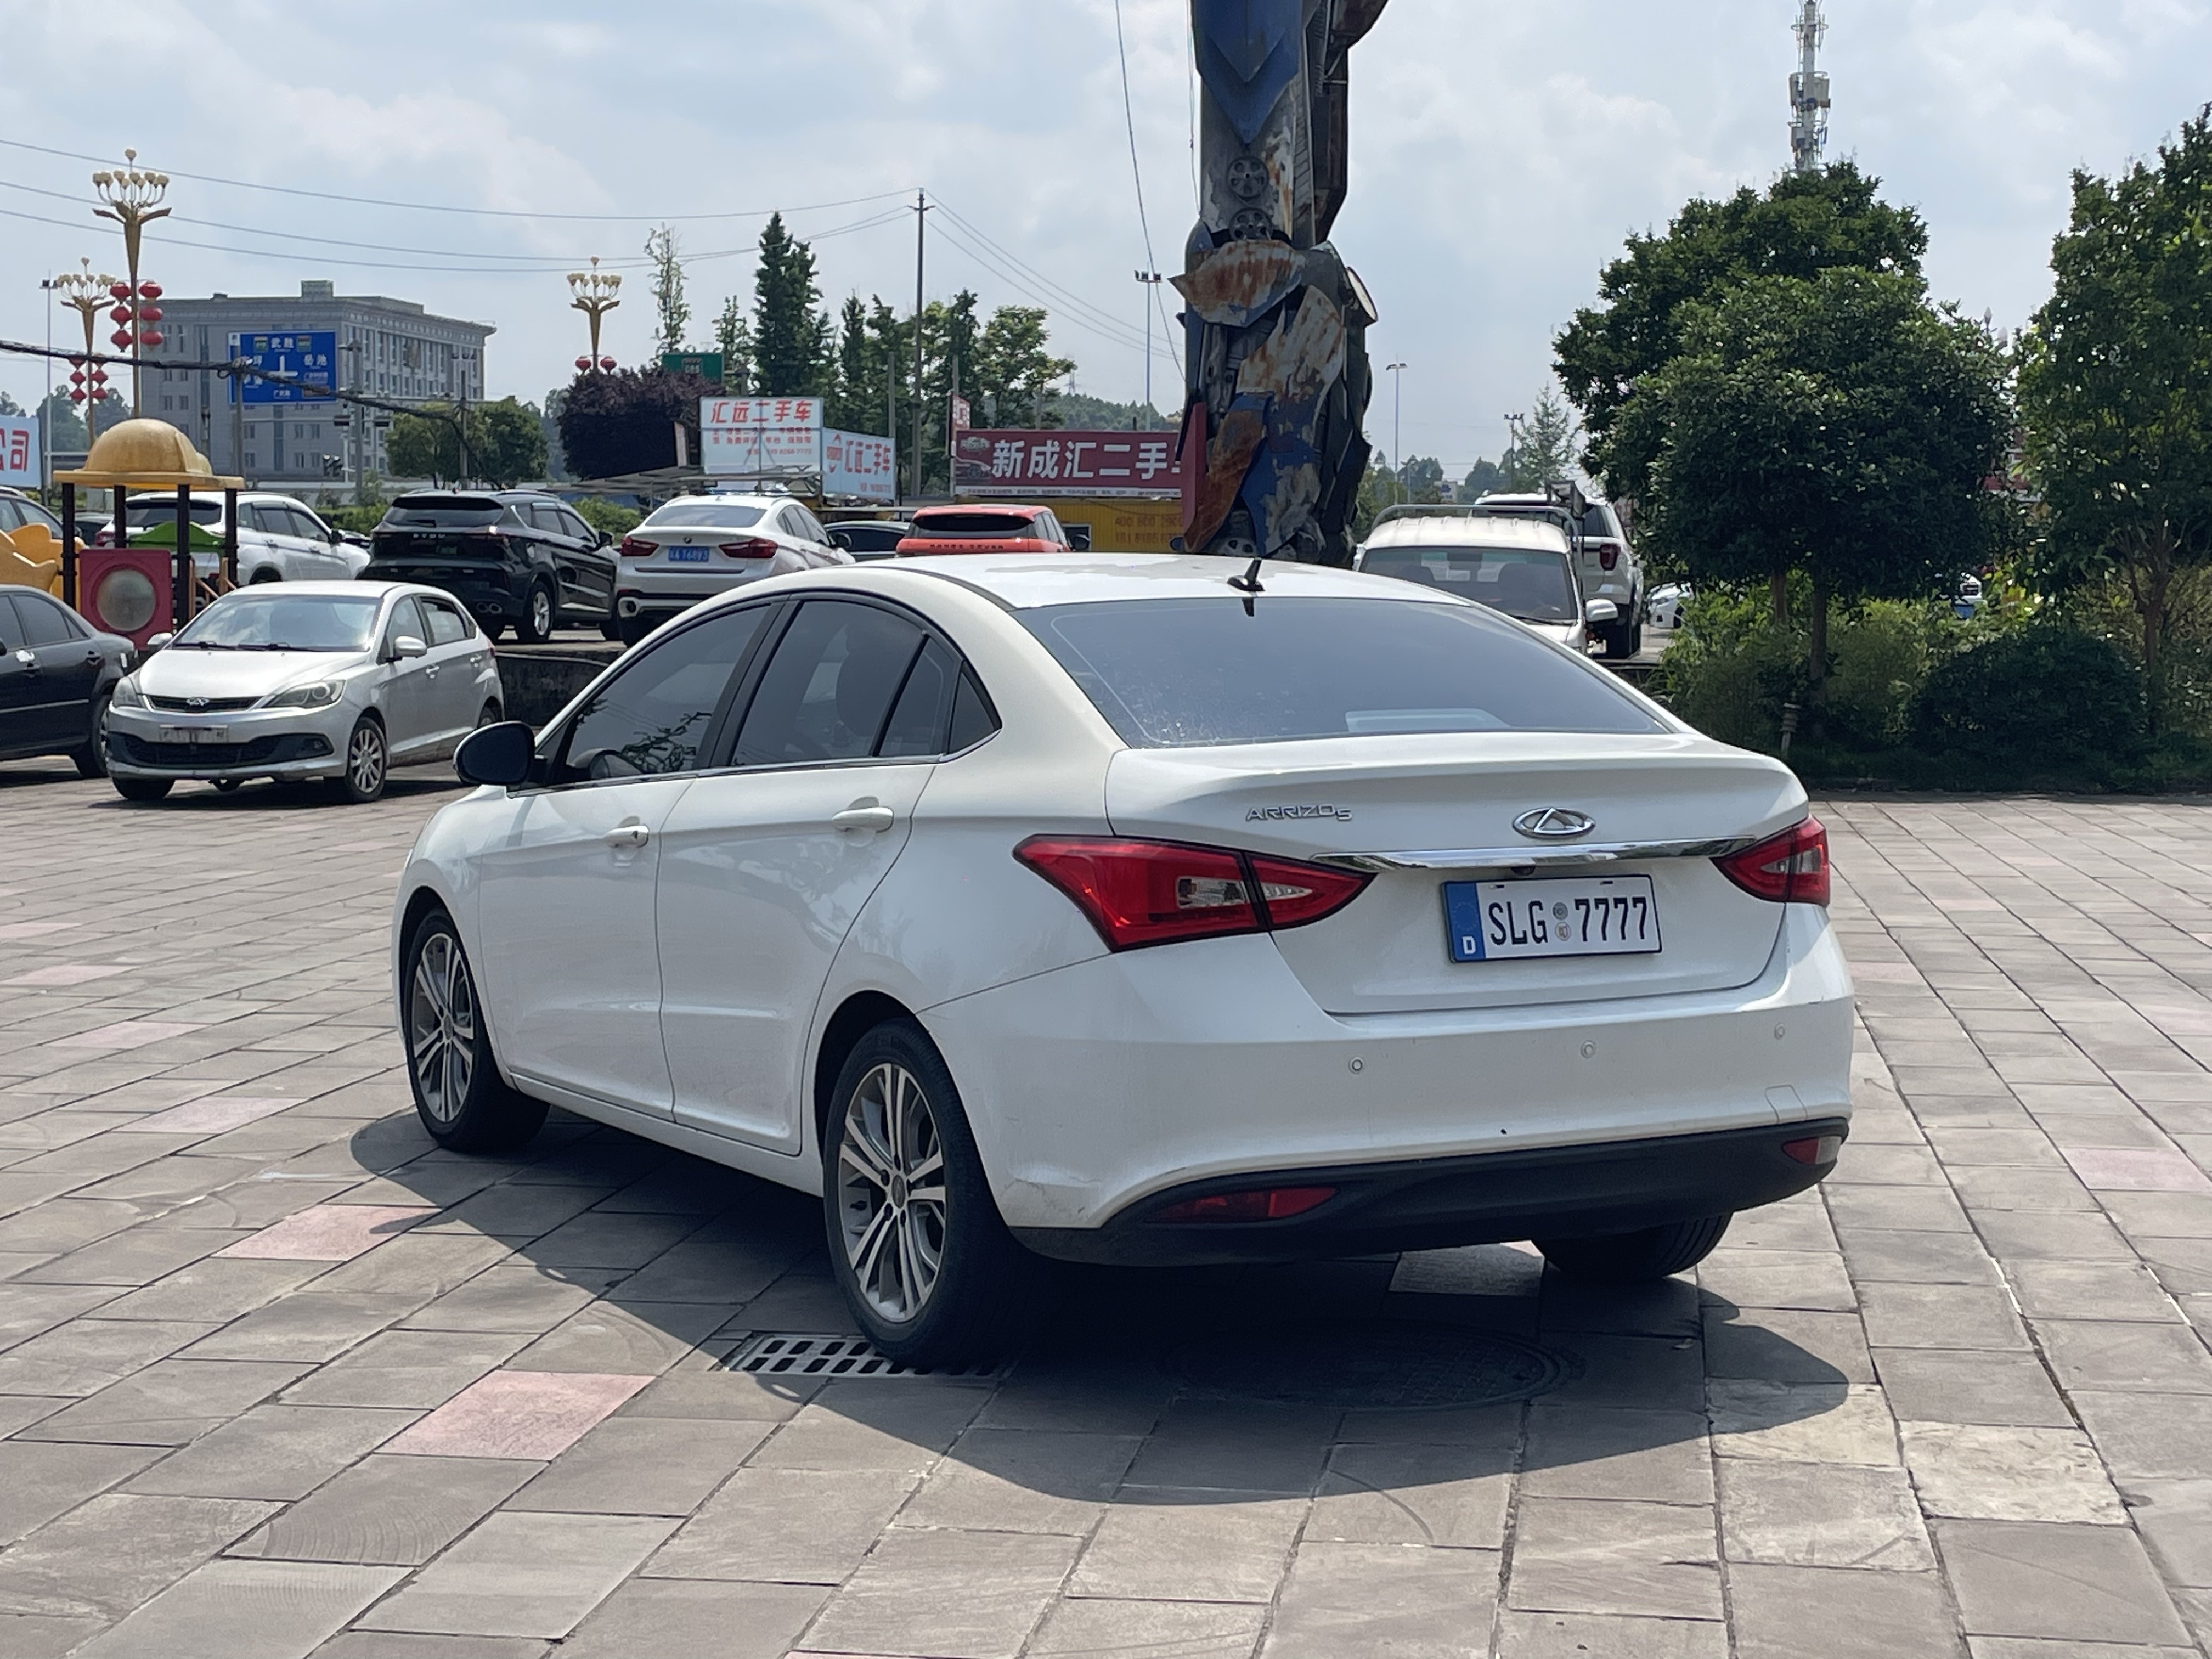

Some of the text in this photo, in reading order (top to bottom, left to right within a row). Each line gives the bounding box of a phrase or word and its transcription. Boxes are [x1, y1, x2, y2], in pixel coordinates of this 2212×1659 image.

[711, 400, 813, 424] 汇远二手车
[991, 439, 1181, 481] 新成汇二手
[1488, 896, 1647, 945] SLG 7777
[1462, 936, 1476, 955] D
